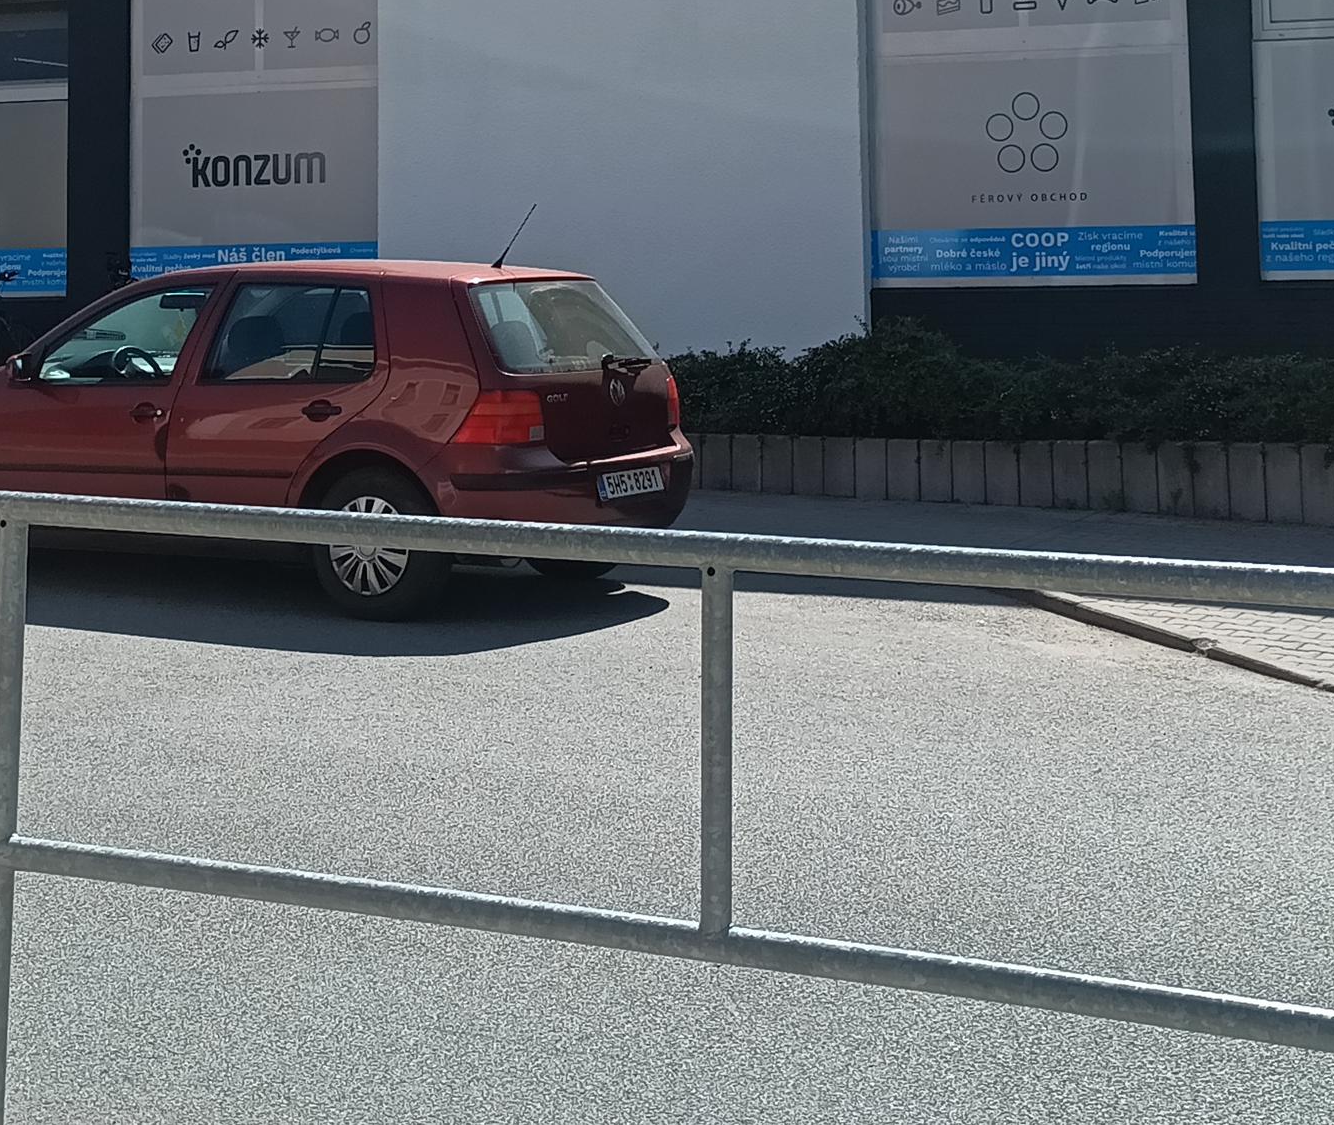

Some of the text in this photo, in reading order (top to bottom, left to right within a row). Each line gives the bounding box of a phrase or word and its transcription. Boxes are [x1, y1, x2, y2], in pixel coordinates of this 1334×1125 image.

[192, 152, 326, 188] KONZUM
[971, 191, 1088, 204] FÉROVÝ OBCHOD
[1011, 232, 1069, 248] COOP
[1078, 230, 1143, 241] Zisk vracíme
[884, 246, 924, 255] partnery
[1091, 242, 1131, 253] regionu
[1270, 241, 1313, 251] Kvalitní
[217, 247, 286, 263] Náš člen
[936, 248, 1000, 258] Dobré české
[1275, 252, 1314, 262] našeho
[931, 261, 962, 271] mléko
[975, 261, 1007, 271] máslo
[1009, 251, 1070, 272] je jiný
[131, 264, 163, 273] Kvalitní
[546, 393, 568, 403] GOLF
[606, 469, 659, 495] 5H5 8291
